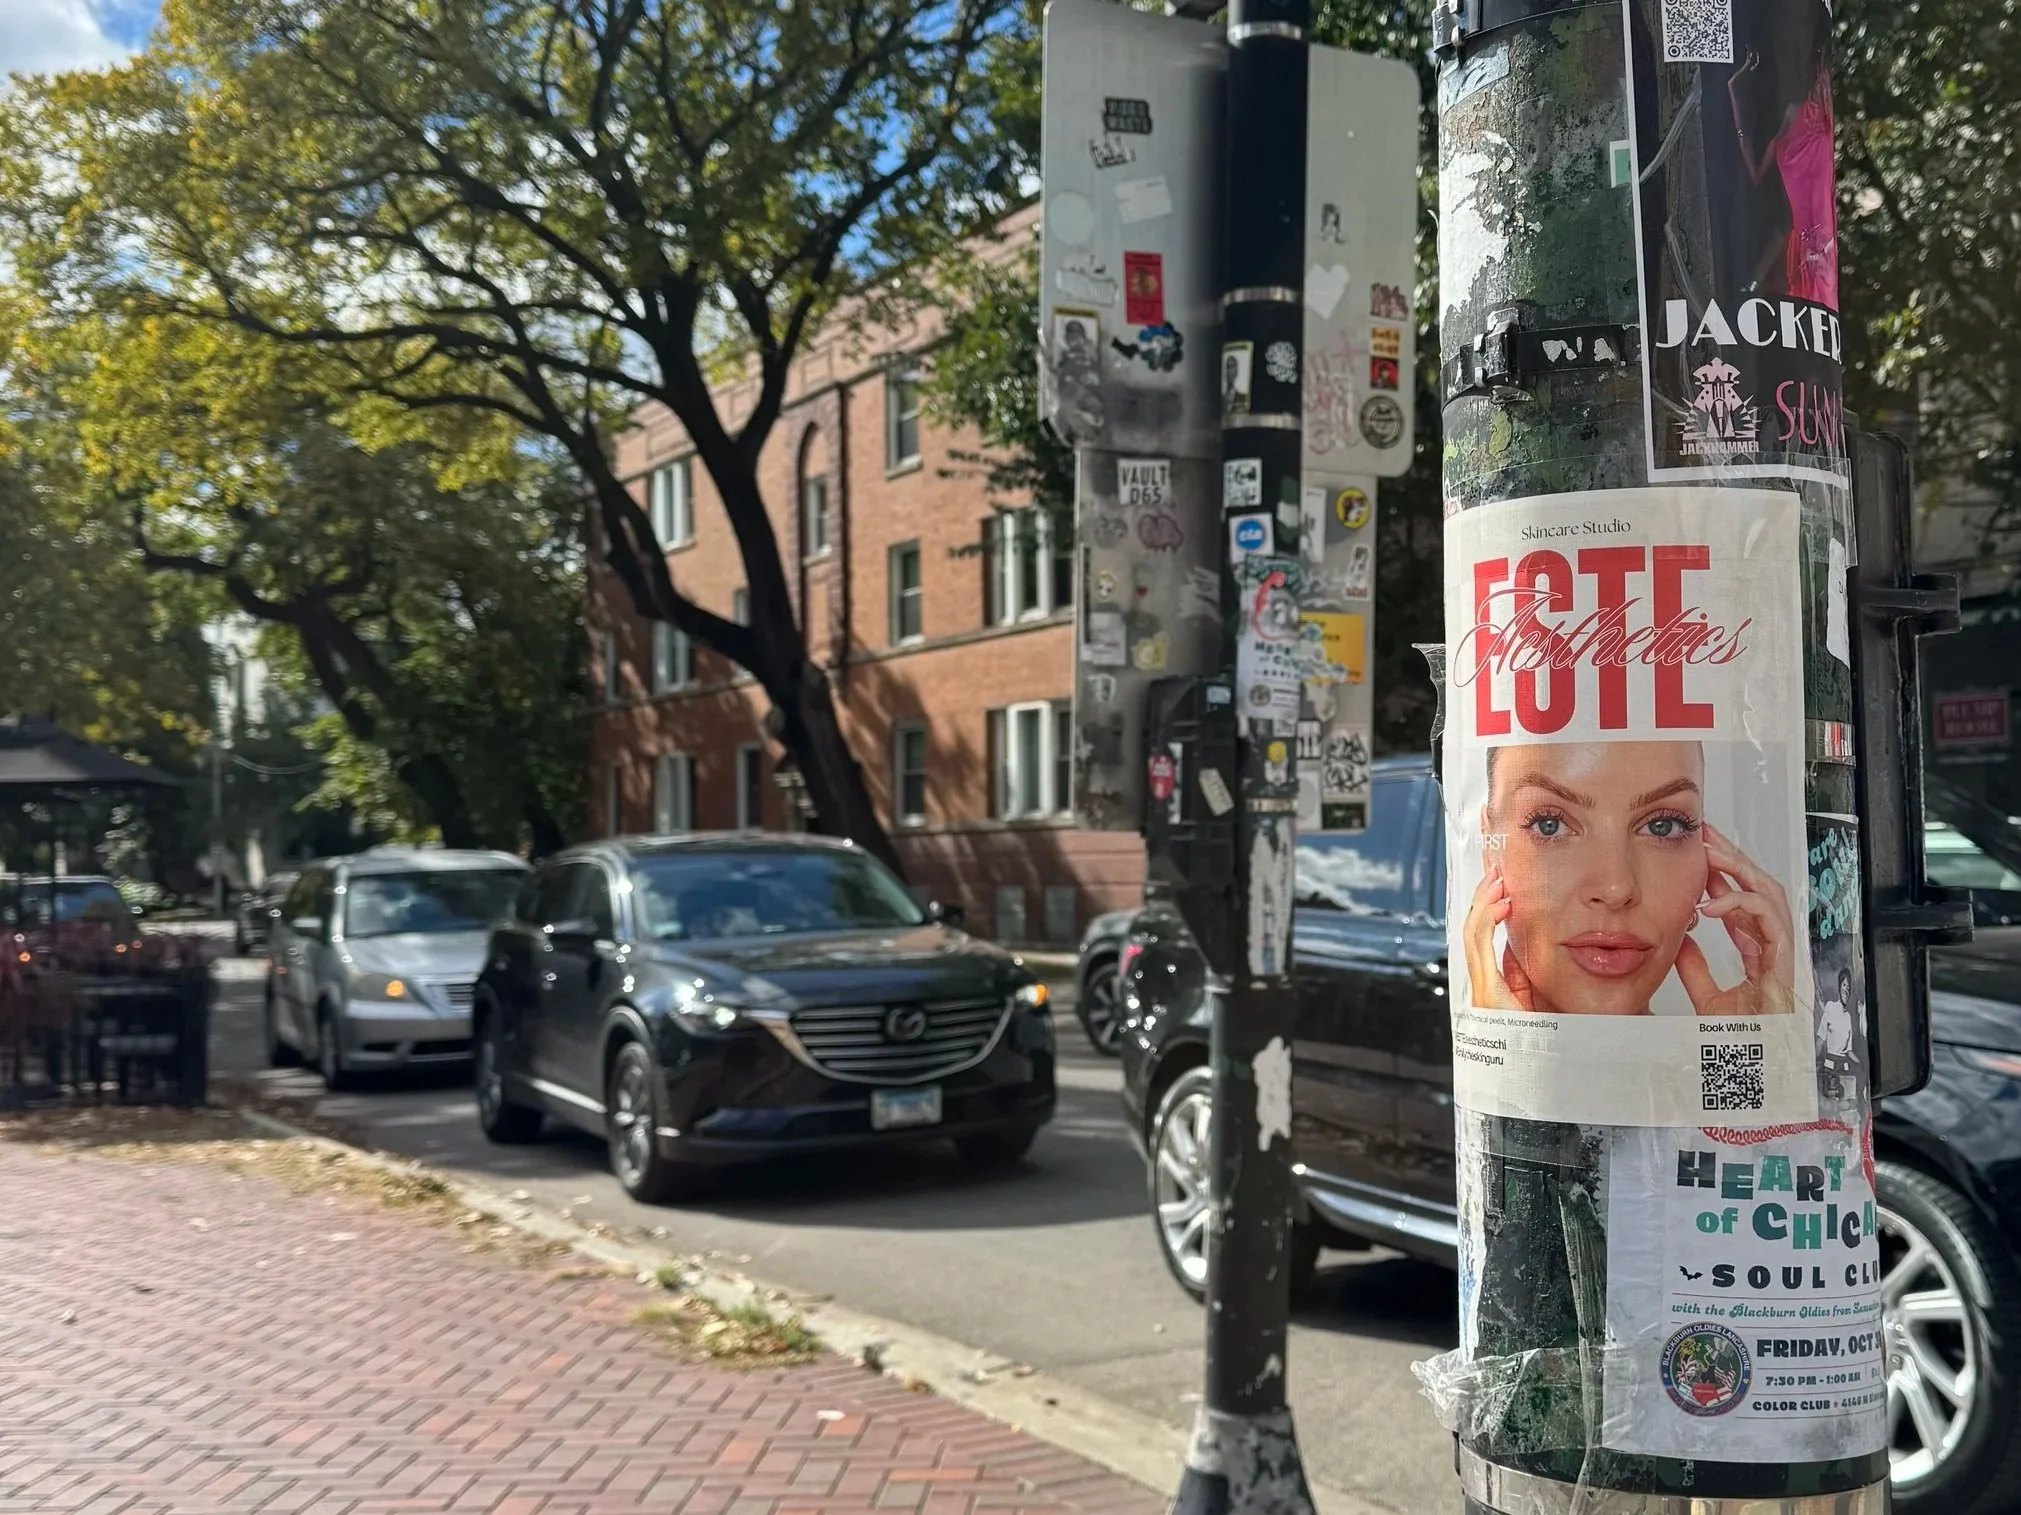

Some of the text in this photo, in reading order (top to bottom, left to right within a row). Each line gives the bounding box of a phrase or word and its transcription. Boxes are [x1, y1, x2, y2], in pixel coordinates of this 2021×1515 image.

[1655, 298, 1842, 365] JACKER
[1775, 379, 1843, 449] SUN
[1121, 465, 1169, 486] VAULT
[1521, 518, 1631, 541] Skincare Studio
[1453, 586, 1753, 688] Aesthetics
[1473, 544, 1714, 736] ESTE
[1507, 1018, 1559, 1031] Microneedling
[1699, 1022, 1762, 1033] Book With Us
[1676, 1149, 1846, 1202] HEART
[1695, 1201, 1878, 1250] of CHICA
[1711, 1263, 1826, 1290] SOUL
[1671, 1302, 1701, 1318] with
[1705, 1303, 1726, 1317] the
[1728, 1303, 1796, 1319] Blackburn
[1798, 1305, 1831, 1319] Oldies
[1832, 1304, 1852, 1317] from
[1662, 1324, 1751, 1371] BLACKBURN OLDIES LANCASHIRE
[1756, 1337, 1846, 1359] FRIDAY,
[1848, 1332, 1874, 1355] OCT
[1765, 1375, 1794, 1387] 7:30
[1797, 1374, 1817, 1386] PM
[1826, 1373, 1847, 1385] 1:00
[1848, 1371, 1861, 1383] AM
[1752, 1400, 1798, 1412] COLOR
[1800, 1399, 1831, 1411] CLUB
